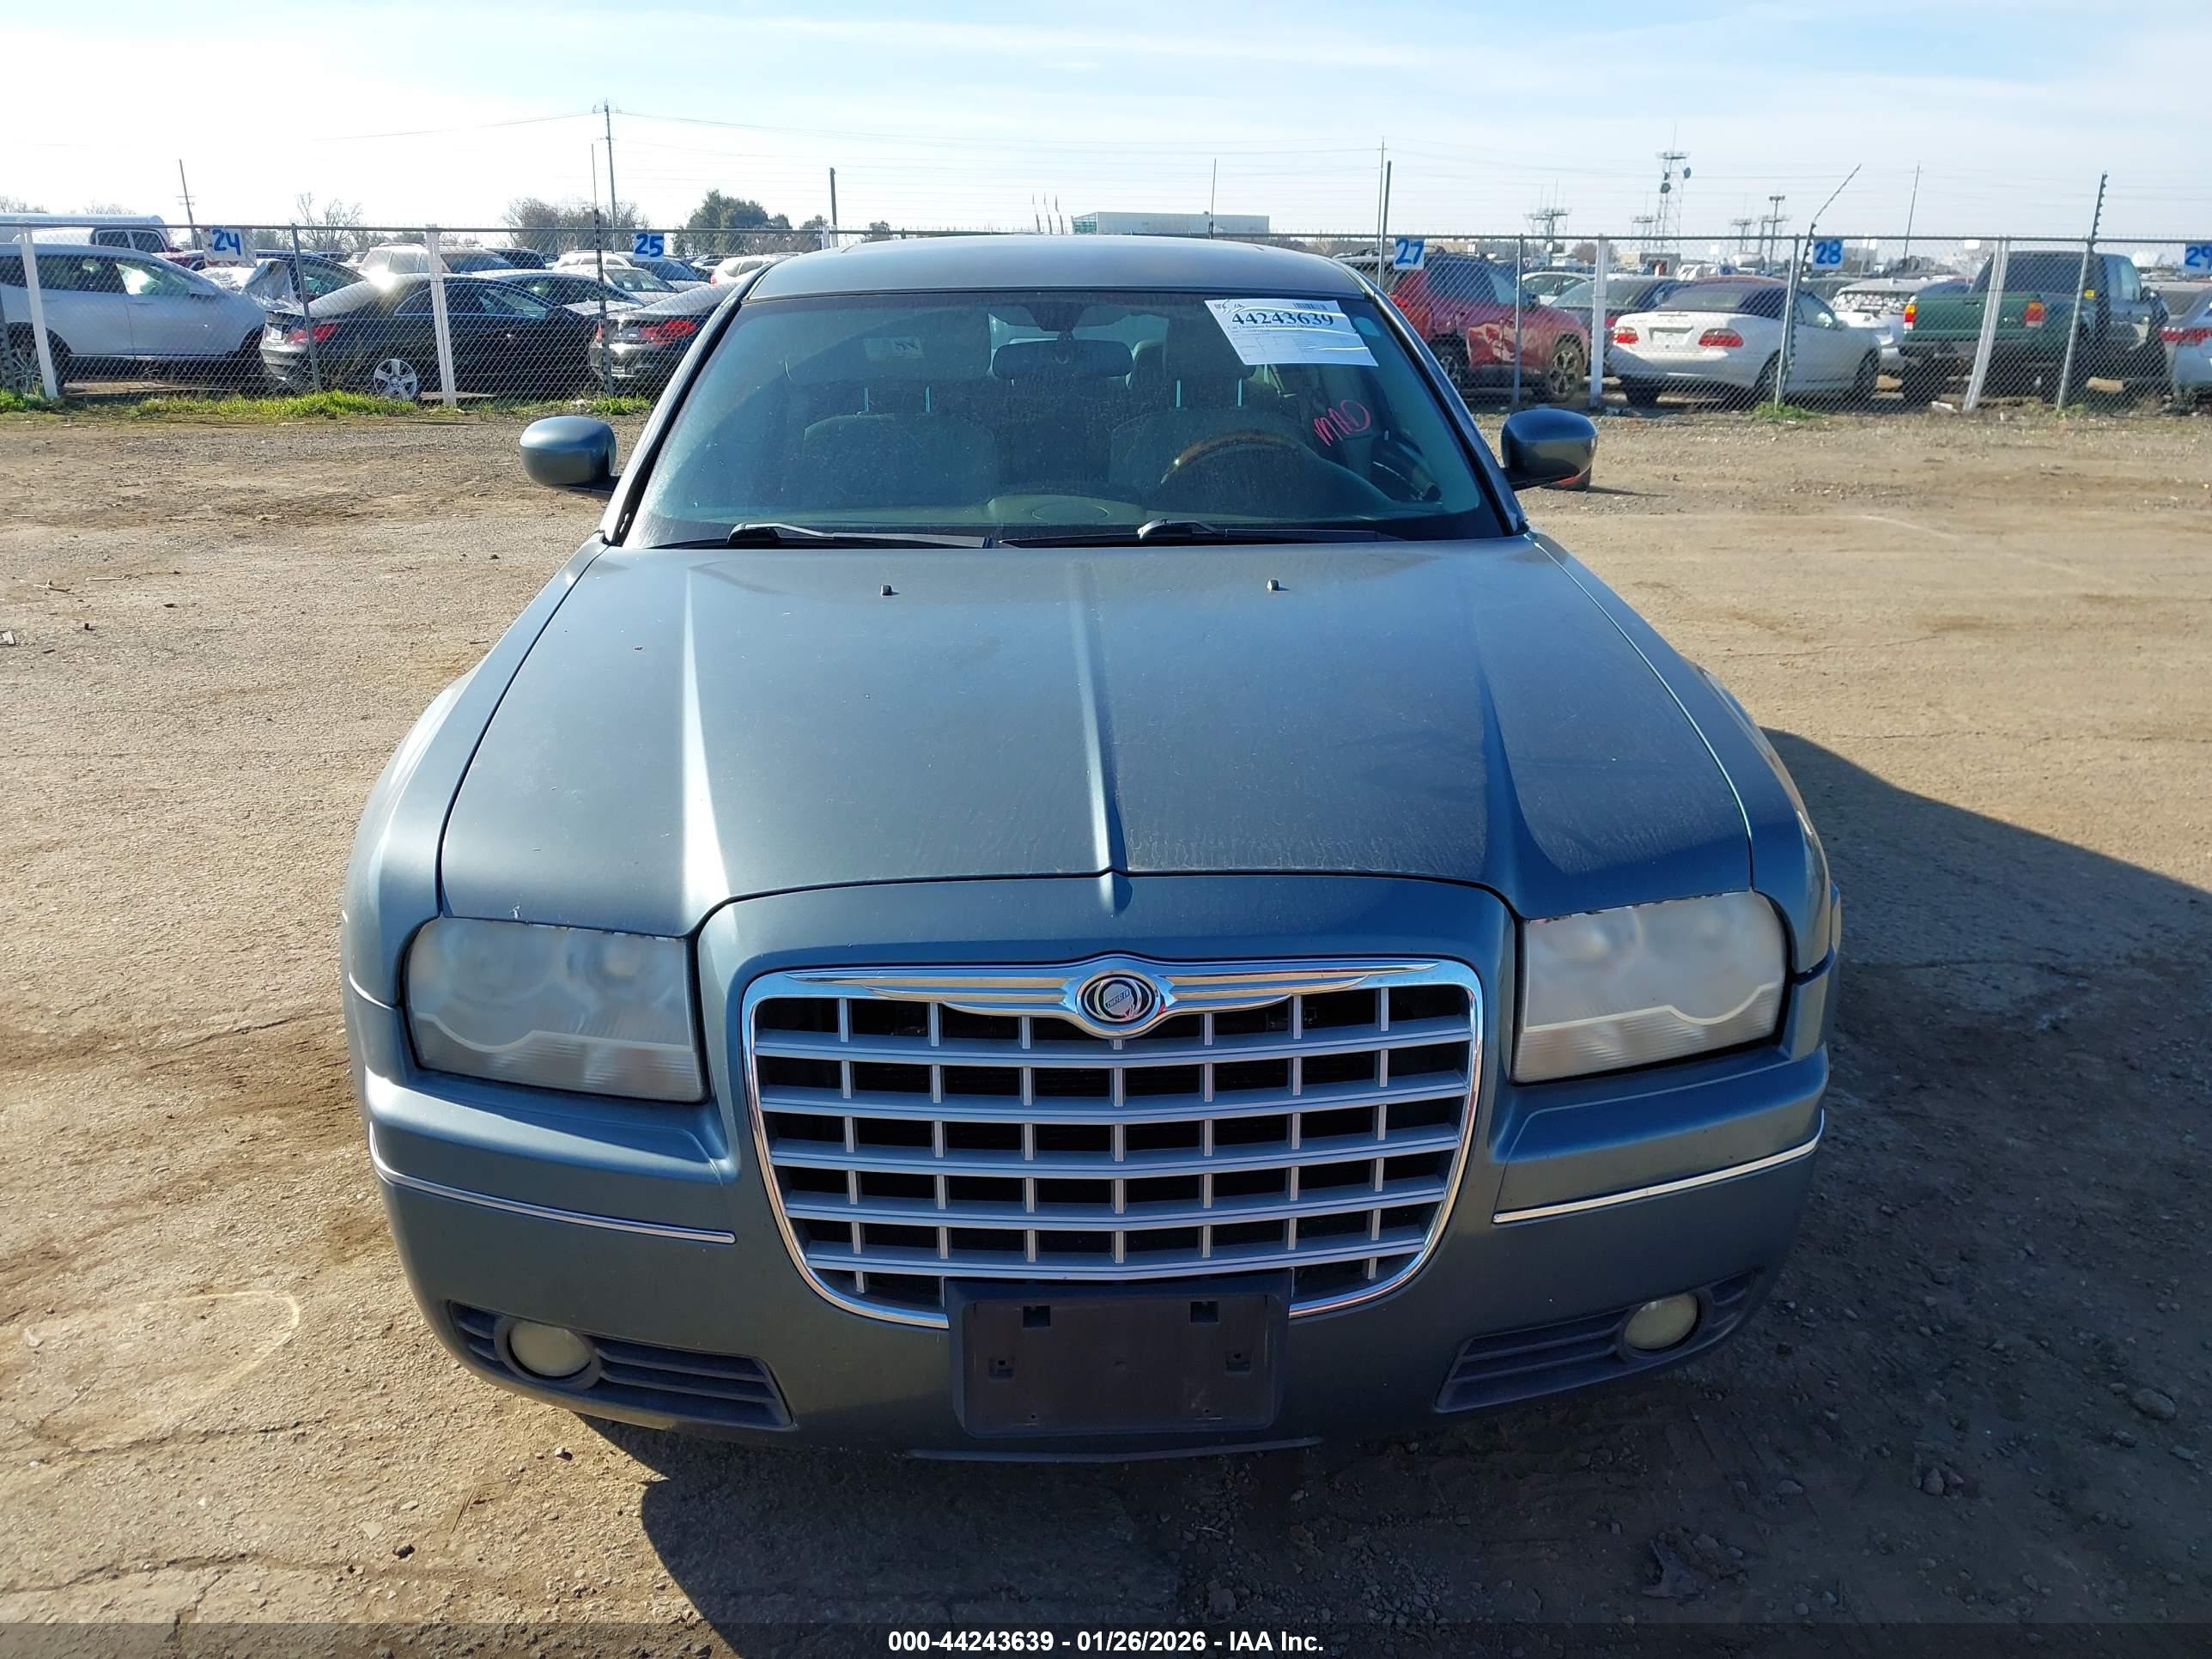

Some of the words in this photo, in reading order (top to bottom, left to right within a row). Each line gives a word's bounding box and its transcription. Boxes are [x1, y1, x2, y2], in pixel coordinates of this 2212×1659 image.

[212, 228, 241, 256] 24
[635, 233, 664, 258] 25
[1395, 237, 1425, 265] 27
[1814, 239, 1842, 264] 28
[2185, 246, 2212, 270] 29
[1231, 312, 1334, 325] 44243639
